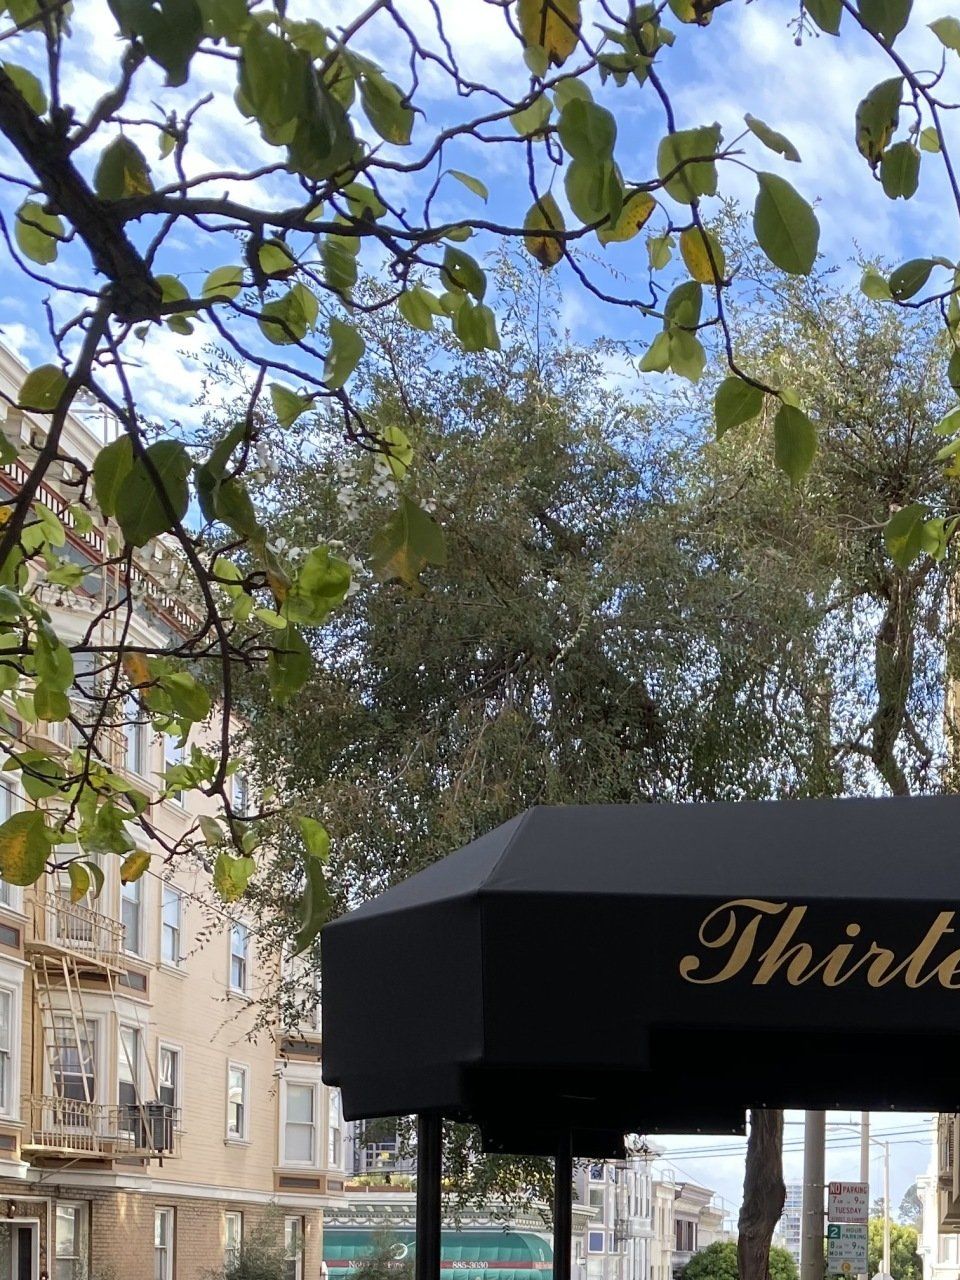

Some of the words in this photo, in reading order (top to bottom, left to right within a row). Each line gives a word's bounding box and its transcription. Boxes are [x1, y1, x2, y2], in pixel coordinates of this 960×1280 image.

[830, 1184, 841, 1194] NO
[842, 1186, 868, 1195] PARKING
[830, 1227, 839, 1238] 2
